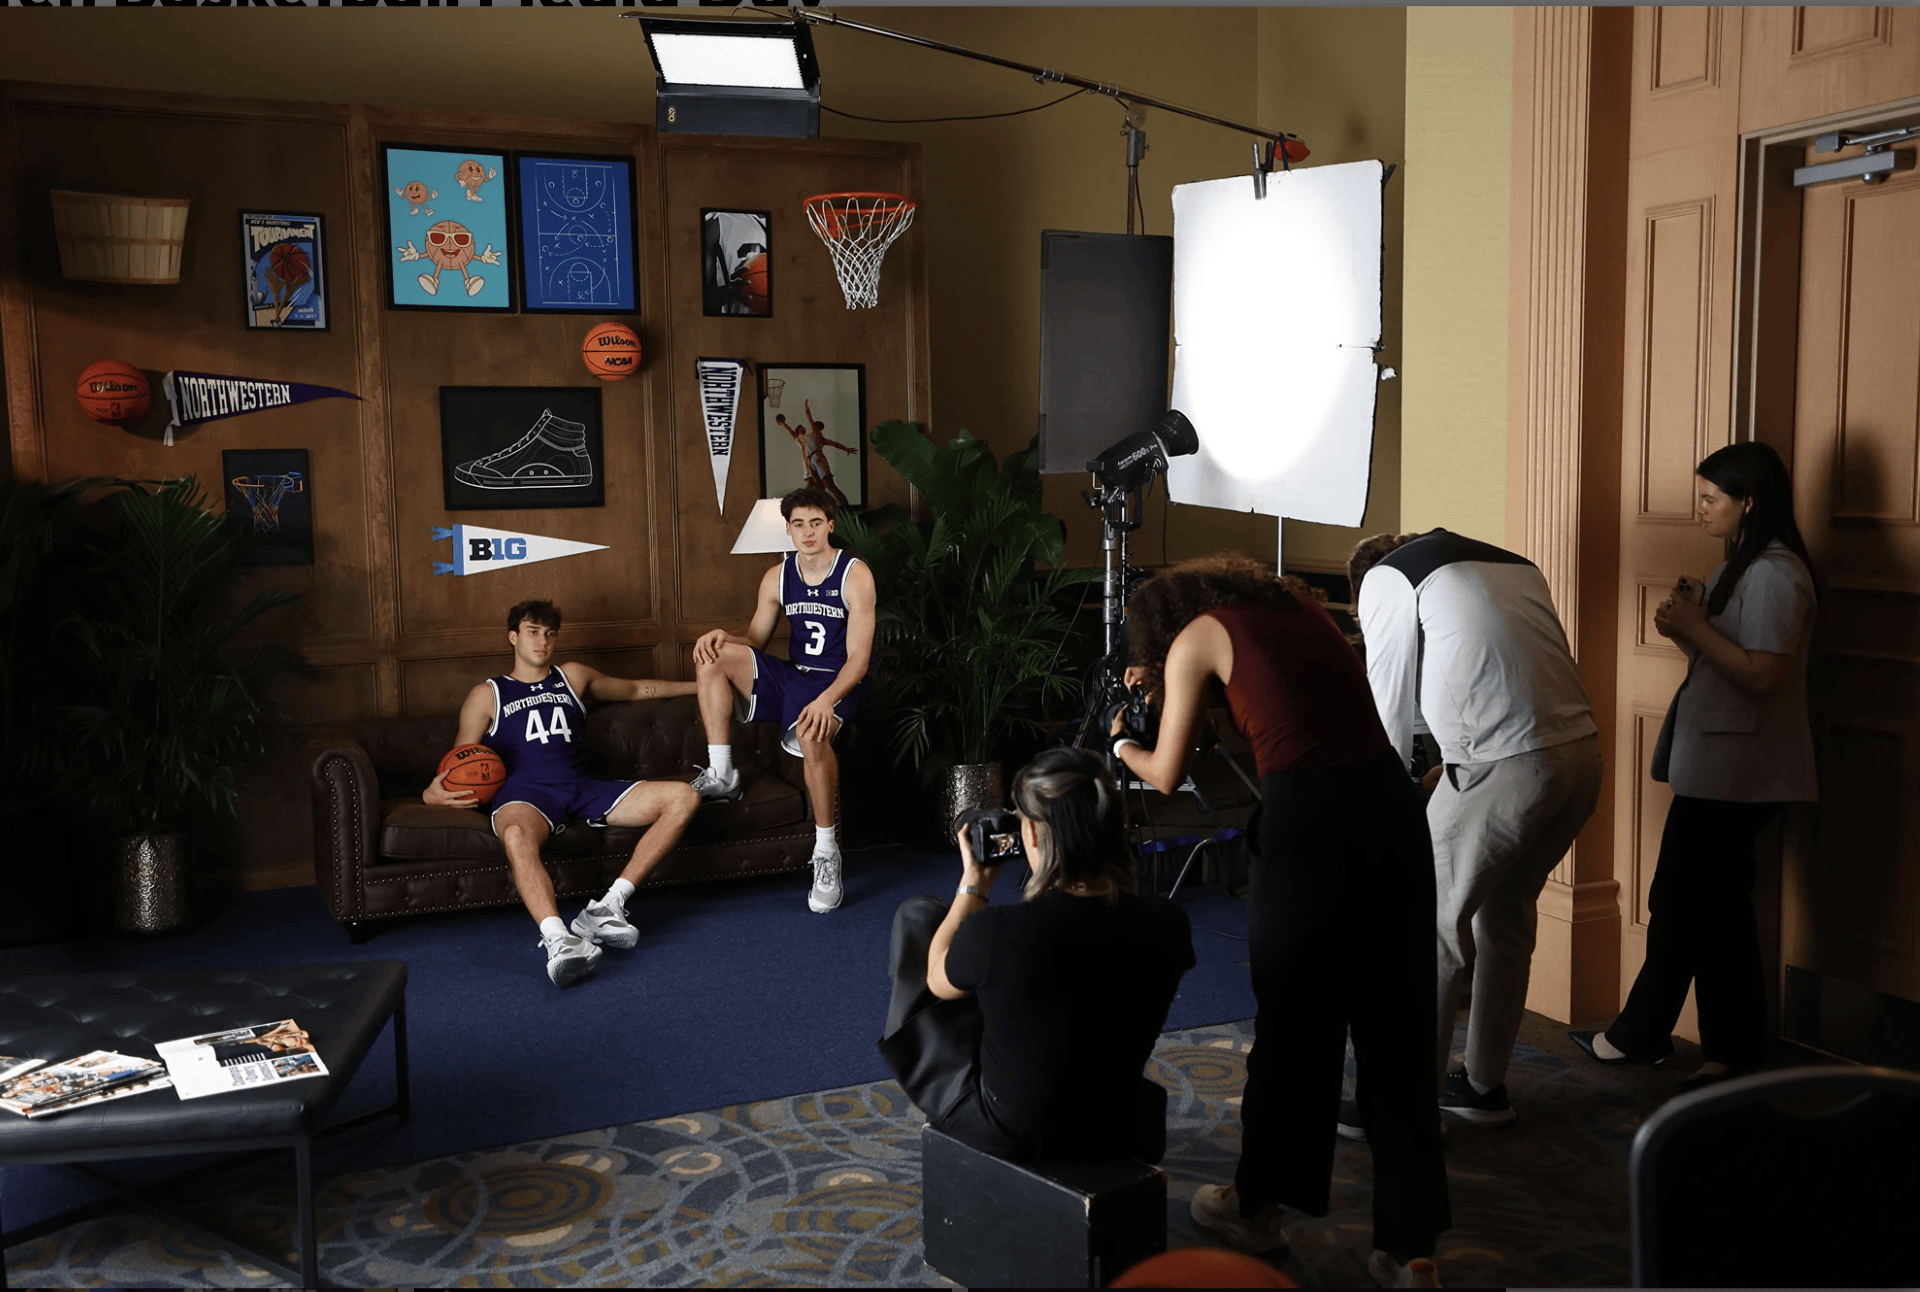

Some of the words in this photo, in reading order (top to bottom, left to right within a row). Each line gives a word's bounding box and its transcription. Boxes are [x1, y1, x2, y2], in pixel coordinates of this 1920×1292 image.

[250, 224, 315, 253] TOURNAMENT
[598, 335, 637, 349] Wilson
[605, 357, 633, 366] NCAA
[89, 380, 138, 393] Wilson
[178, 376, 291, 421] NORTHWESTERN
[701, 366, 737, 456] NORTHWESTERN
[804, 620, 827, 656] 3
[525, 706, 573, 745] 44
